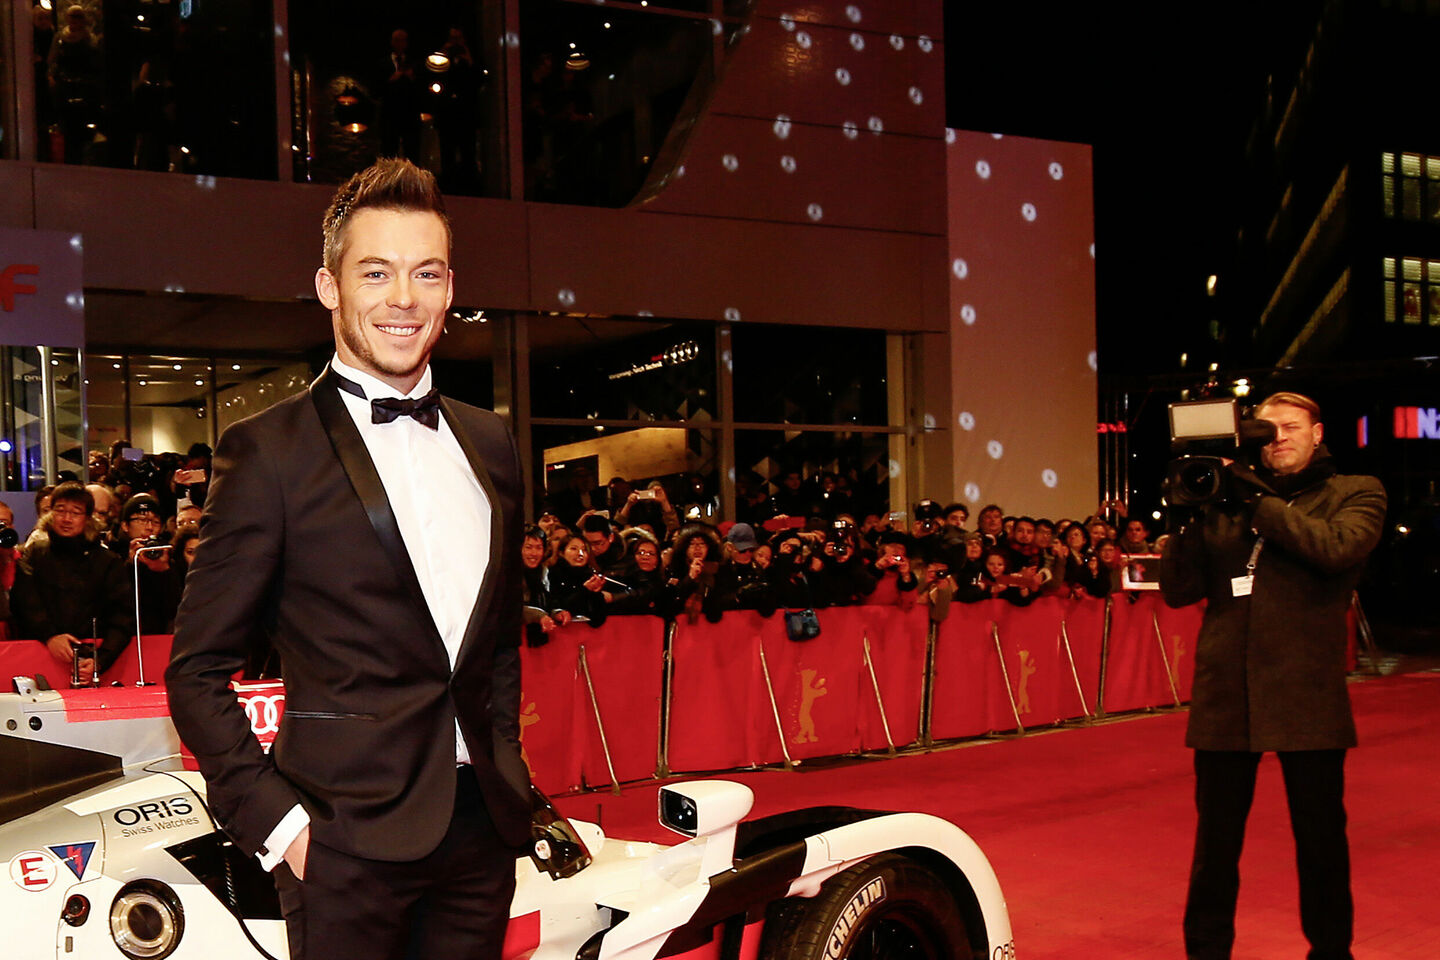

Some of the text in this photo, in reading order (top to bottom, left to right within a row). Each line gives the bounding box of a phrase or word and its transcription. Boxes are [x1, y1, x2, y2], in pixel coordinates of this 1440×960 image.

[113, 796, 193, 826] ORIS
[121, 816, 200, 838] Swiss Watches
